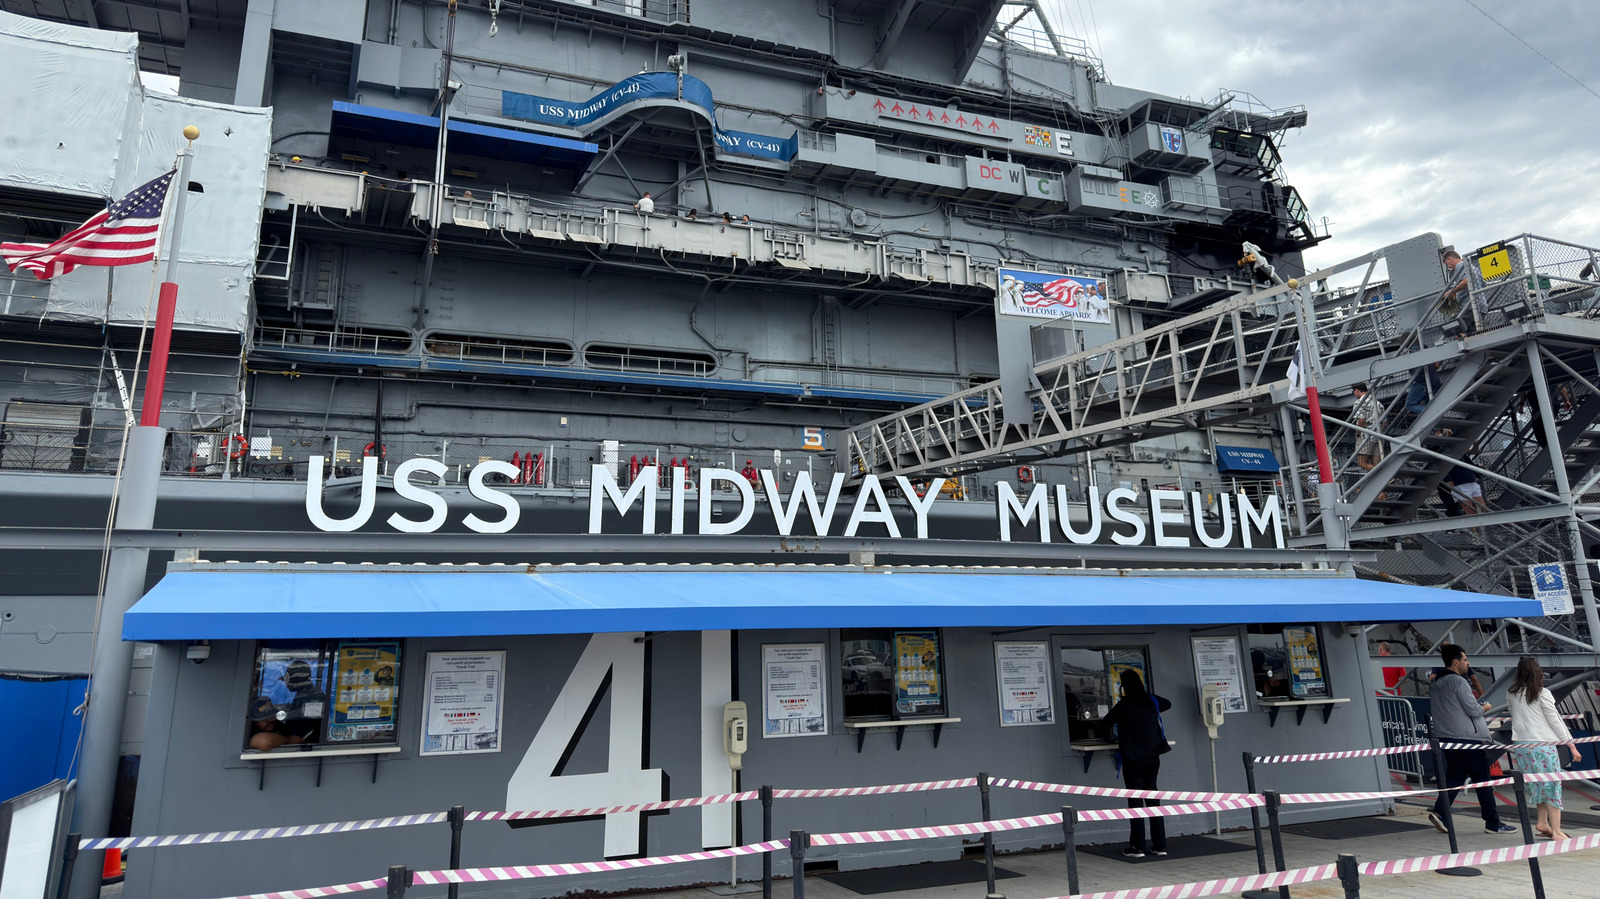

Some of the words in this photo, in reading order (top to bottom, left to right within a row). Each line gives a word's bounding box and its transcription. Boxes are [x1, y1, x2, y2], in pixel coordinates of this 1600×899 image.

[540, 104, 564, 117] USS
[567, 96, 608, 119] MIDWAY
[611, 82, 640, 102] (CV-41)
[746, 139, 780, 152] (CV-41)
[1055, 131, 1074, 155] E
[980, 165, 1002, 180] DC
[1008, 169, 1020, 183] W
[1038, 178, 1050, 195] C
[1132, 190, 1142, 205] E
[1482, 243, 1499, 255] BROW
[1490, 257, 1499, 267] 4
[1019, 306, 1058, 316] WELCOME
[1060, 310, 1092, 319] ABOARD!
[803, 426, 823, 446] 5
[306, 456, 521, 534] USS
[589, 464, 946, 539] MIDWAY
[998, 480, 1286, 549] MUSEUM
[1382, 720, 1405, 730] erica's
